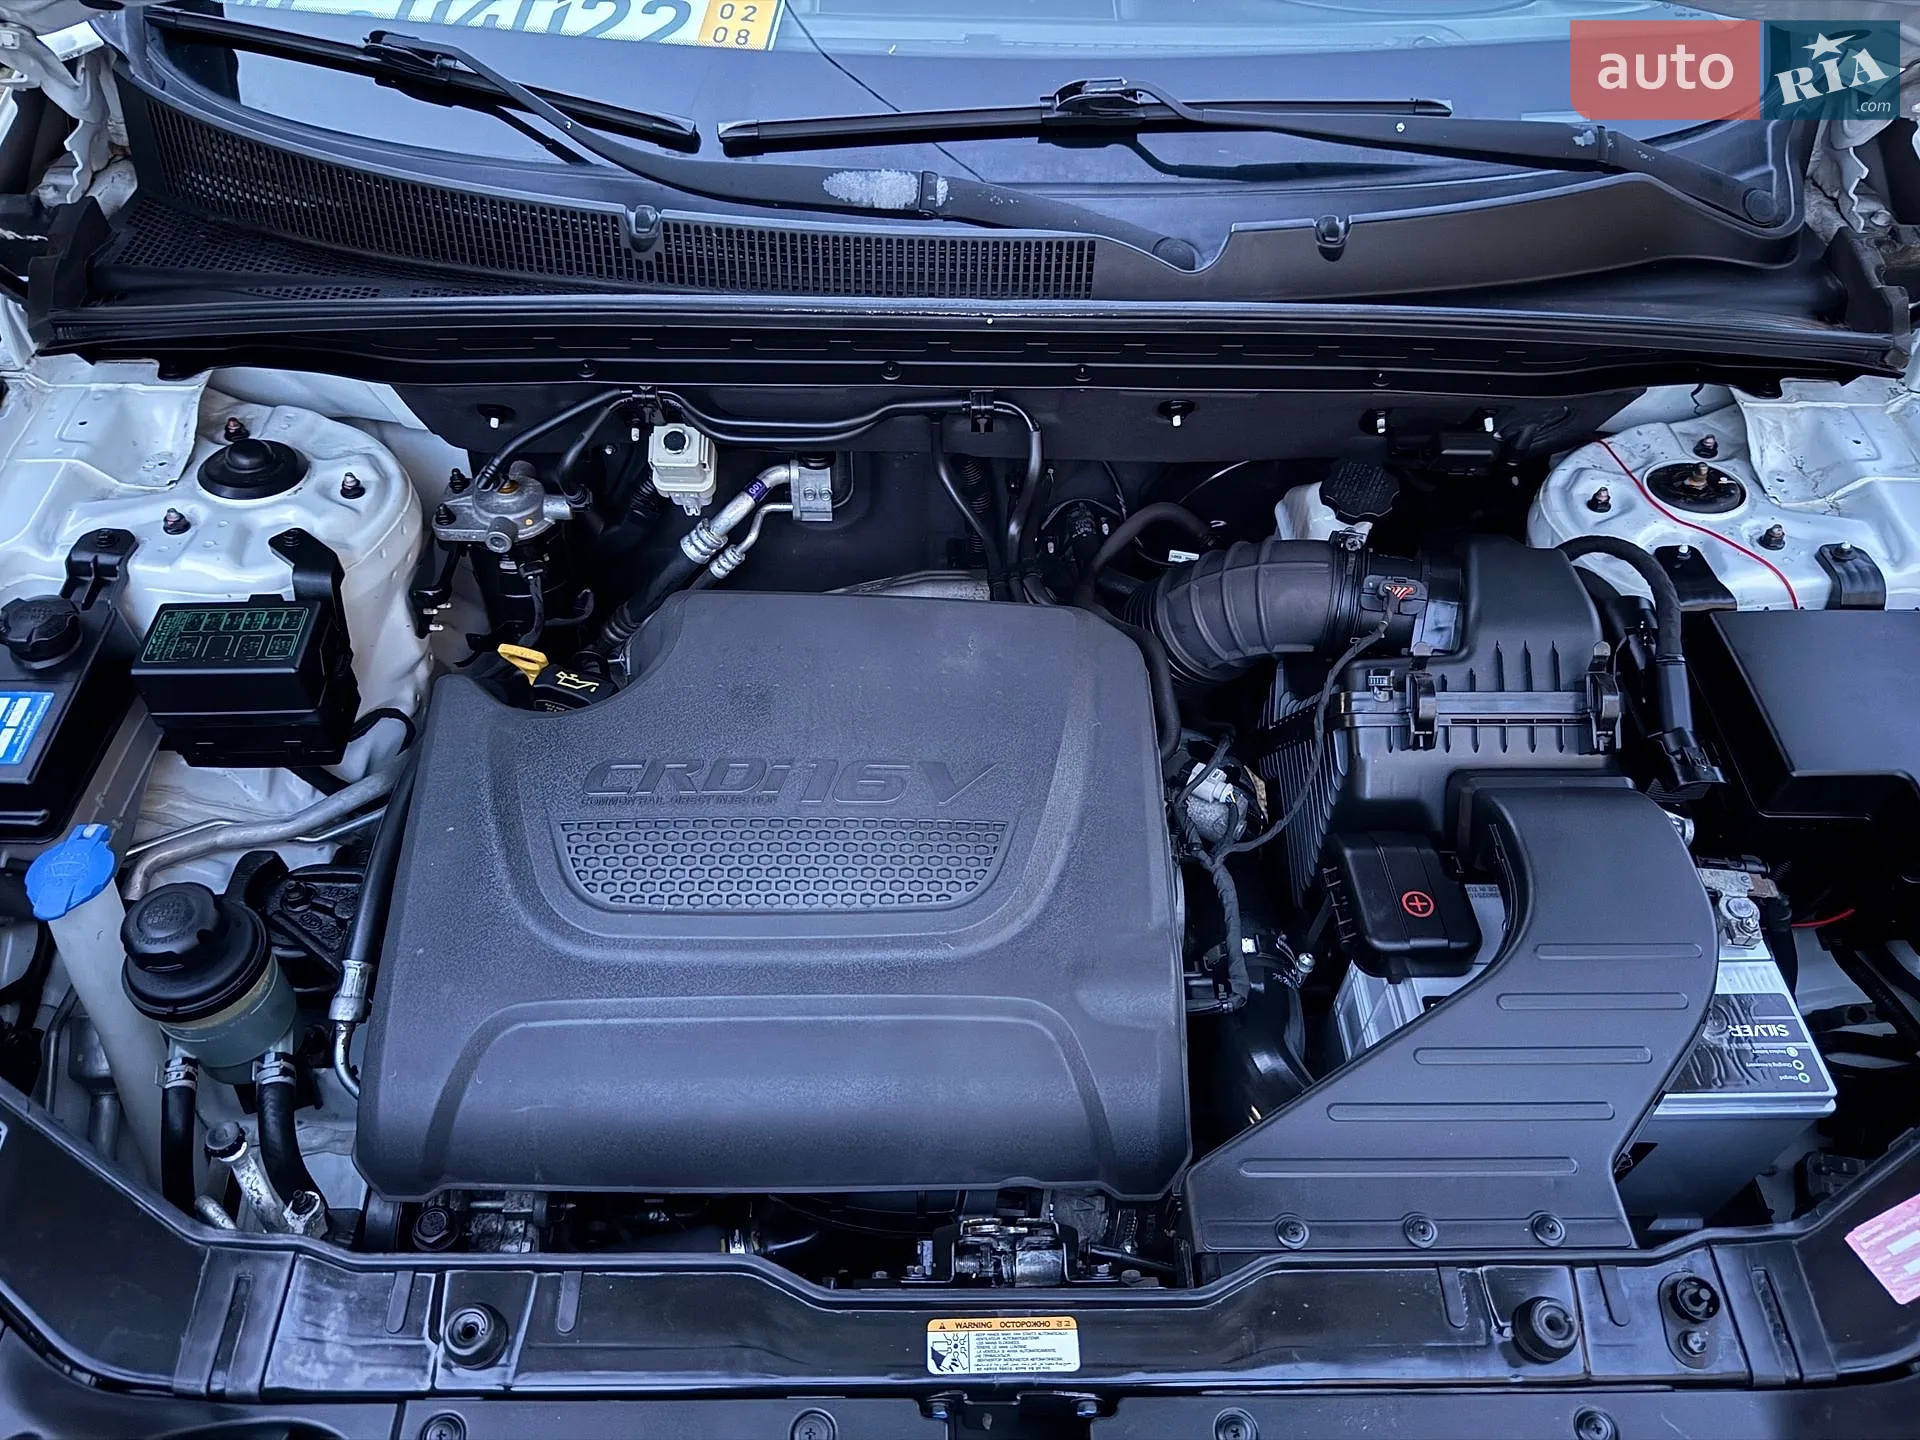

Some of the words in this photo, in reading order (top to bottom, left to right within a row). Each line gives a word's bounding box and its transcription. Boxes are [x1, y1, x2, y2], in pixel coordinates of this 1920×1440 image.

[719, 3, 758, 22] 02
[713, 26, 750, 46] 08
[748, 482, 763, 494] G01
[1727, 1024, 1790, 1037] SILVER
[955, 1321, 993, 1329] WARNING
[999, 1320, 1051, 1328] ОСТОРОЖНО
